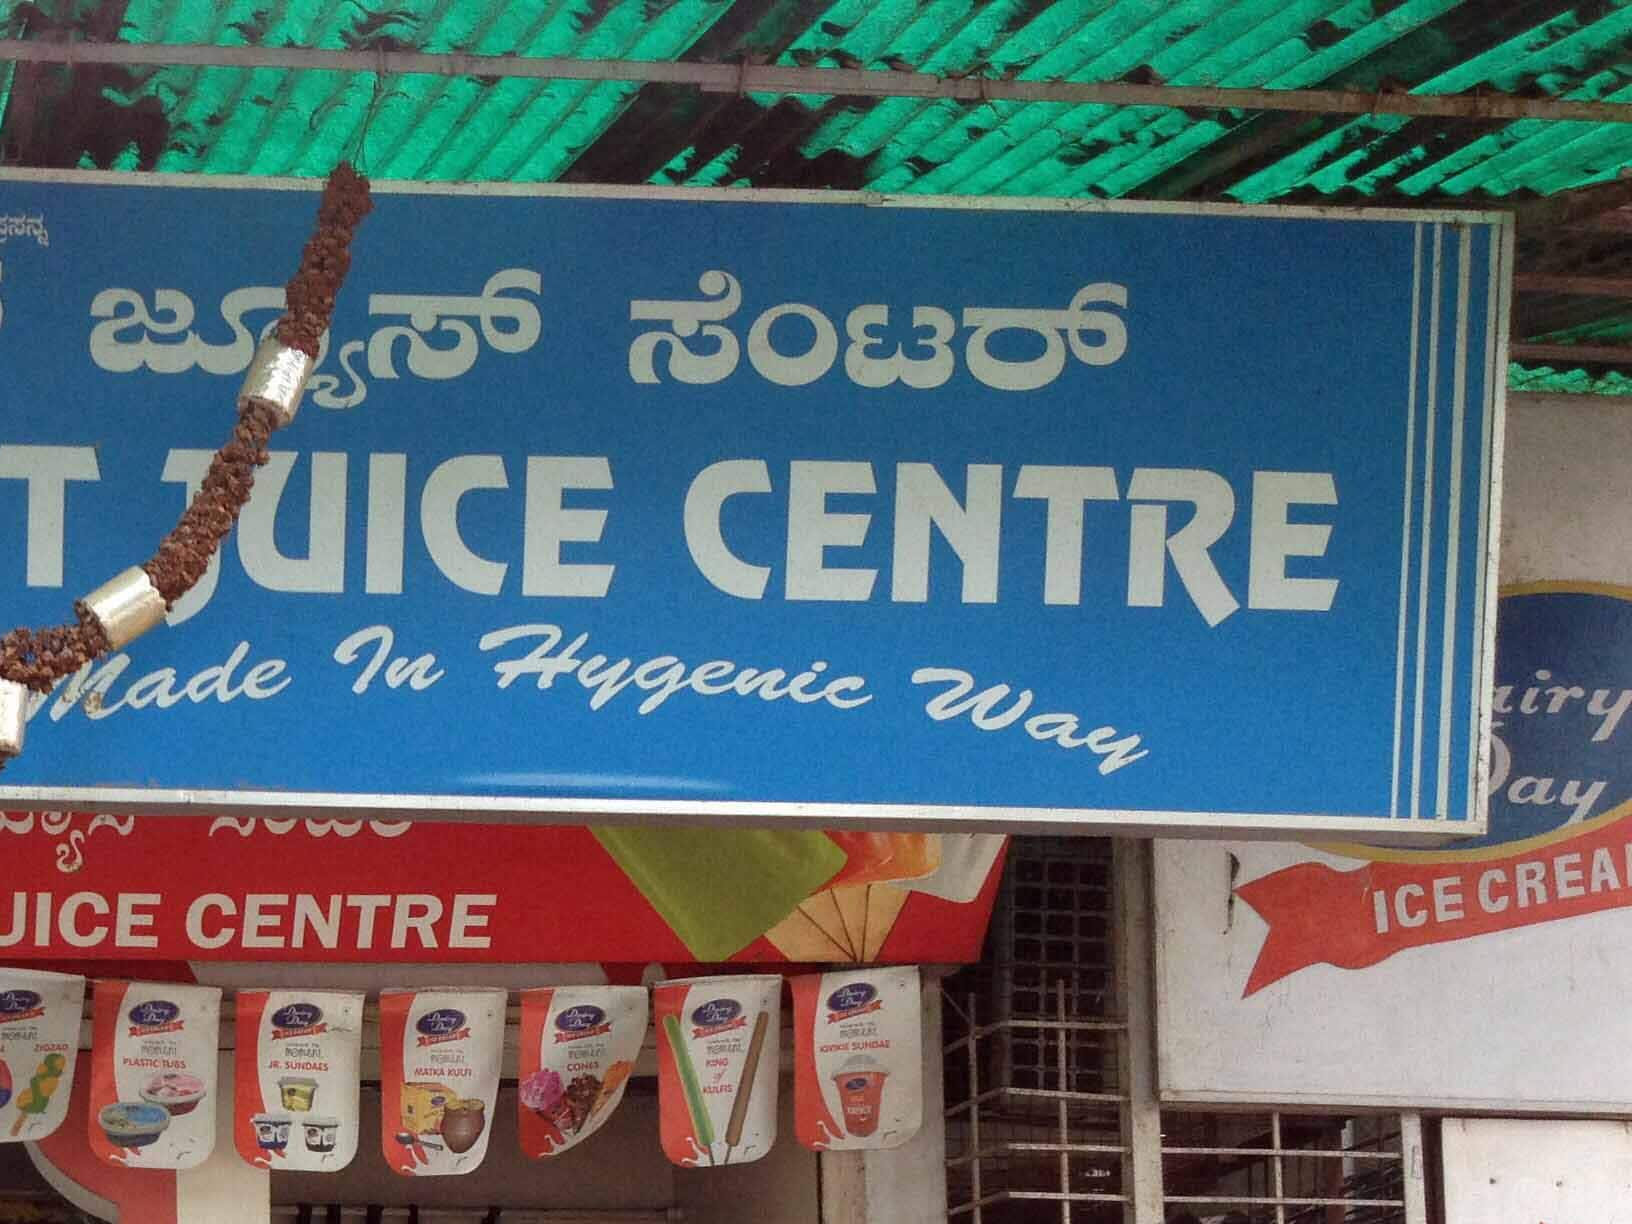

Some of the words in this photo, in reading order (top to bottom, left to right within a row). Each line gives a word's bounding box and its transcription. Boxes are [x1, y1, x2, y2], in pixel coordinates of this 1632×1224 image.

[629, 268, 1128, 392] ಸೆಂಟರ್
[683, 454, 1339, 628] CENTRE
[28, 639, 292, 726] Made
[335, 625, 444, 693] In
[479, 622, 873, 716] Hygenic
[911, 666, 1149, 777] Way
[1493, 668, 1632, 742] airy
[186, 893, 498, 950] CENTRE
[1374, 877, 1465, 934] ICE
[1478, 841, 1632, 914] CREA
[123, 1058, 160, 1069] PLASTIC
